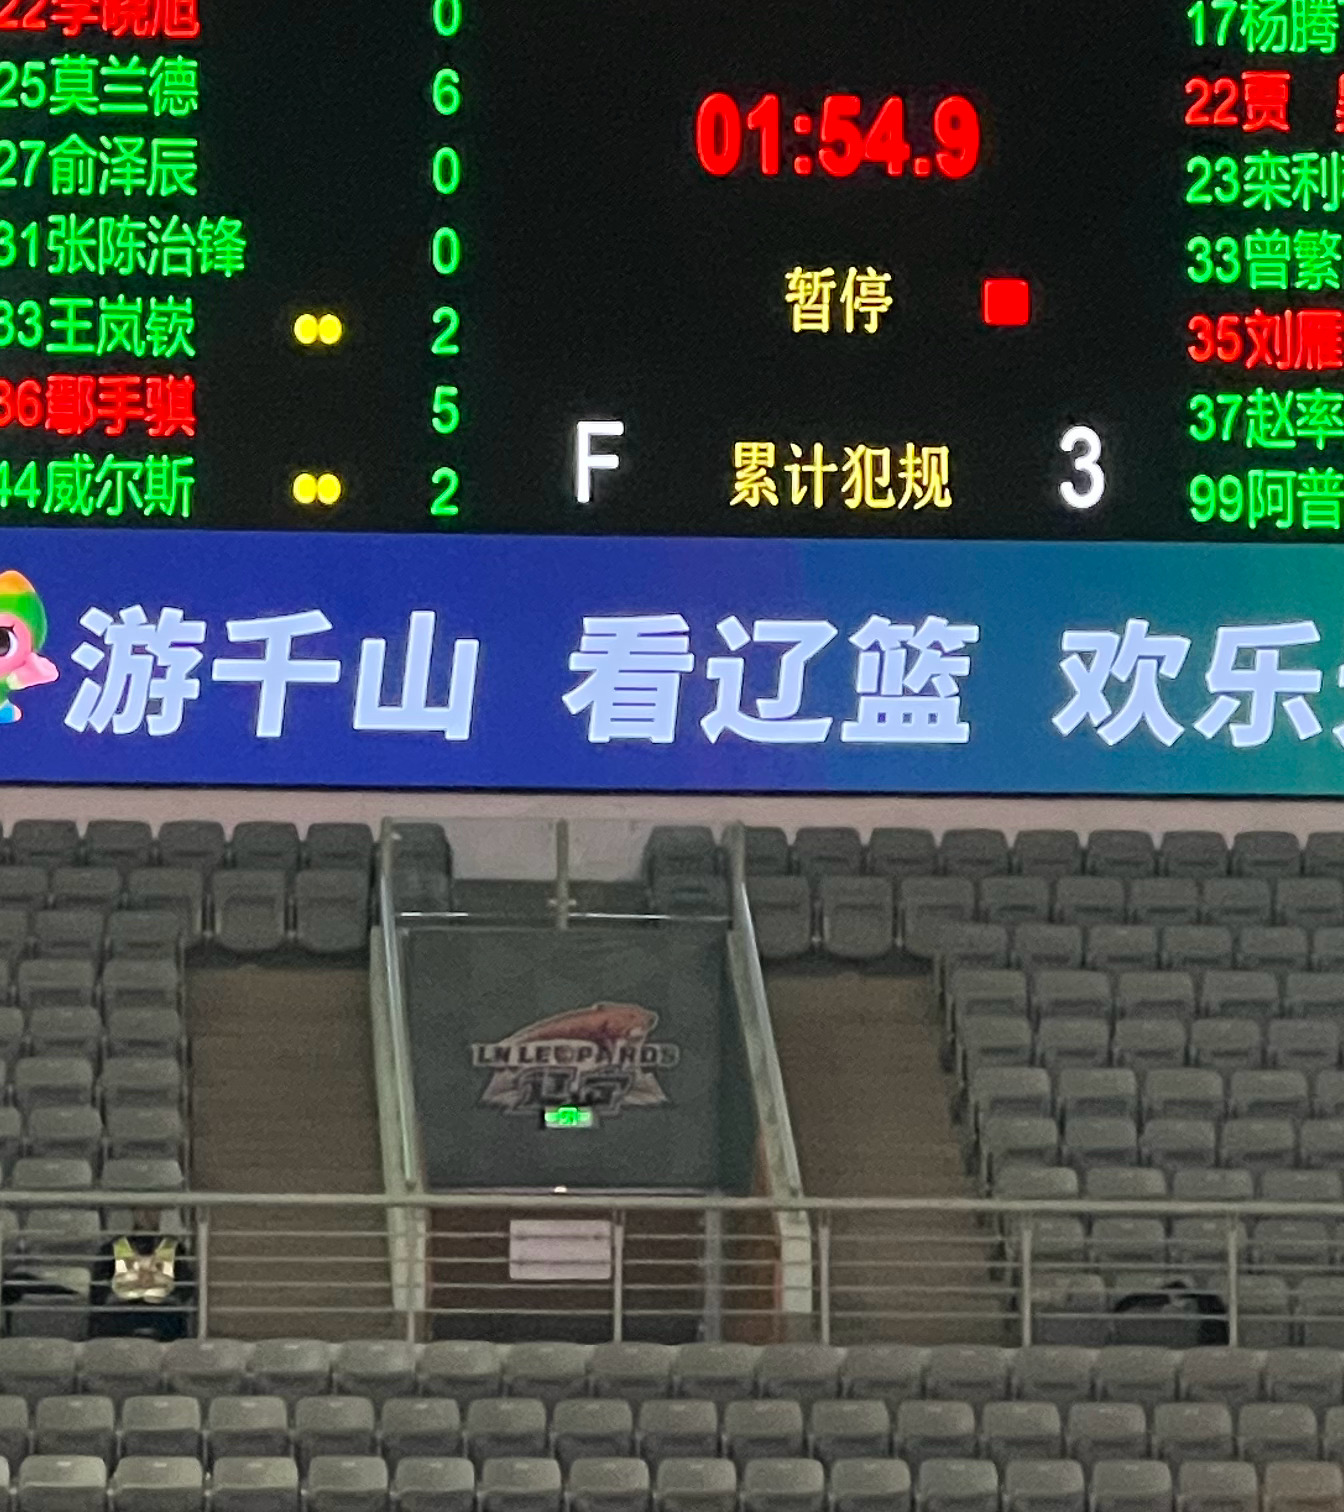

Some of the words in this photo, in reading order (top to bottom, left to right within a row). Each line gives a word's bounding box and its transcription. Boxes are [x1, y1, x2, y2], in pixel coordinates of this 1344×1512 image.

[433, 69, 460, 115] 6
[695, 92, 981, 180] 01:54.9
[433, 147, 460, 194] 0
[433, 227, 460, 274] 0
[785, 267, 893, 334] 暂停
[431, 306, 459, 354] 2
[432, 386, 459, 434] 5
[576, 421, 624, 503] F
[730, 442, 953, 510] 累计犯规
[1060, 426, 1104, 508] 3
[431, 467, 458, 515] 2
[68, 605, 480, 741] 游千山
[562, 613, 980, 744] 看辽篮
